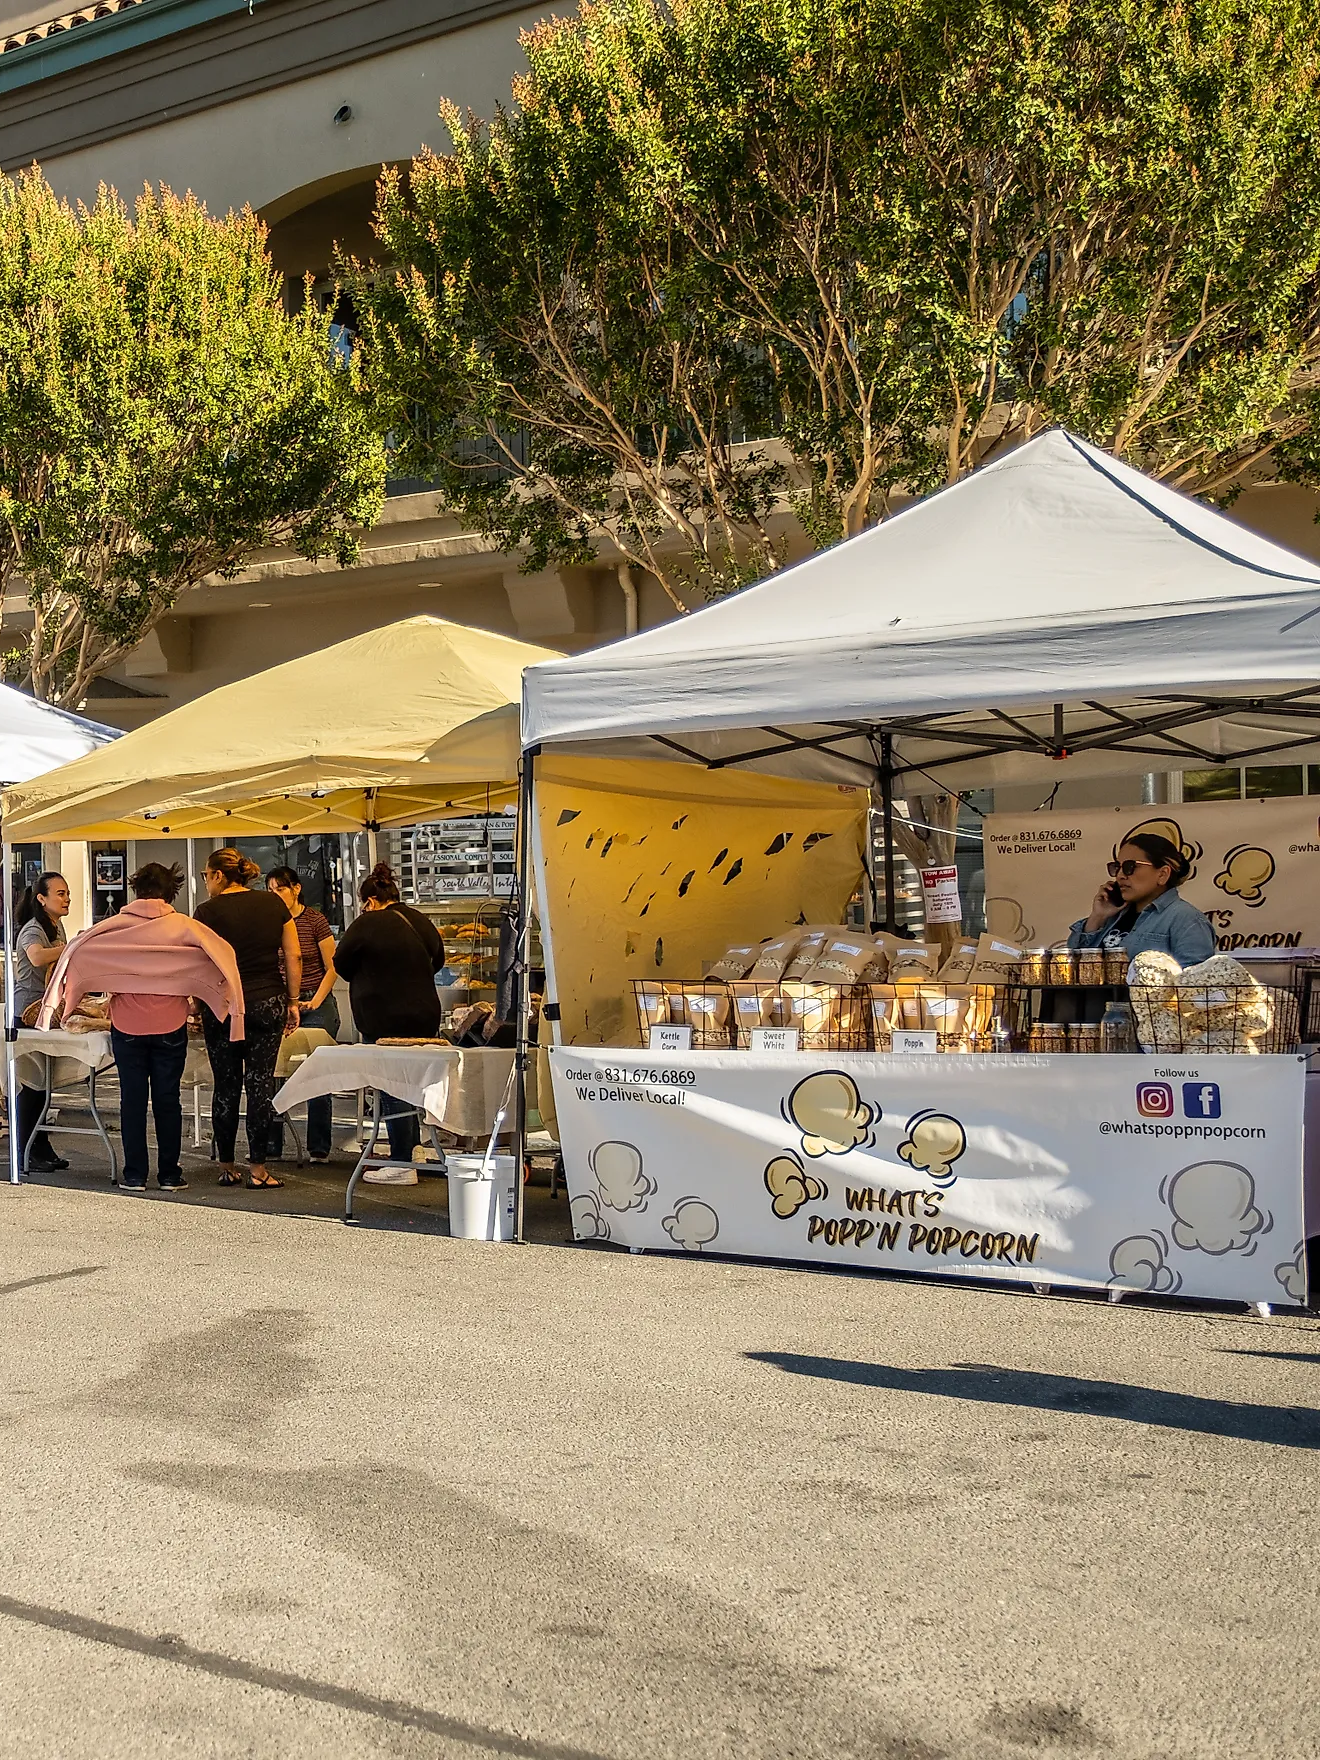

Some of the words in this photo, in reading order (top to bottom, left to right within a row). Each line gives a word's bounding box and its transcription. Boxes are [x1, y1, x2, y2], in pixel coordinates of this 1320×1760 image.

[989, 834, 1011, 843] Order
[1020, 829, 1083, 842] 831.676.6869
[997, 845, 1013, 855] We
[1014, 843, 1047, 854] Deliver
[1048, 842, 1076, 853] Local!
[464, 852, 496, 861] COMPUTR
[660, 1031, 681, 1041] Kettle
[763, 1031, 786, 1040] Sweet
[661, 1042, 677, 1050] Corn
[763, 1041, 786, 1050] White
[566, 1069, 592, 1081] Order
[594, 1070, 604, 1082] @
[605, 1068, 696, 1085] 831.676.6869
[1154, 1068, 1185, 1078] Follow
[1188, 1069, 1199, 1078] us
[575, 1087, 596, 1102] We
[599, 1087, 644, 1103] Deliver
[645, 1089, 686, 1106] Local!
[1099, 1121, 1266, 1141] @whatspoppnpopcorn
[845, 1186, 945, 1218] WHAT'S
[807, 1214, 902, 1252] POPP'N
[908, 1222, 1041, 1267] POPCORN
